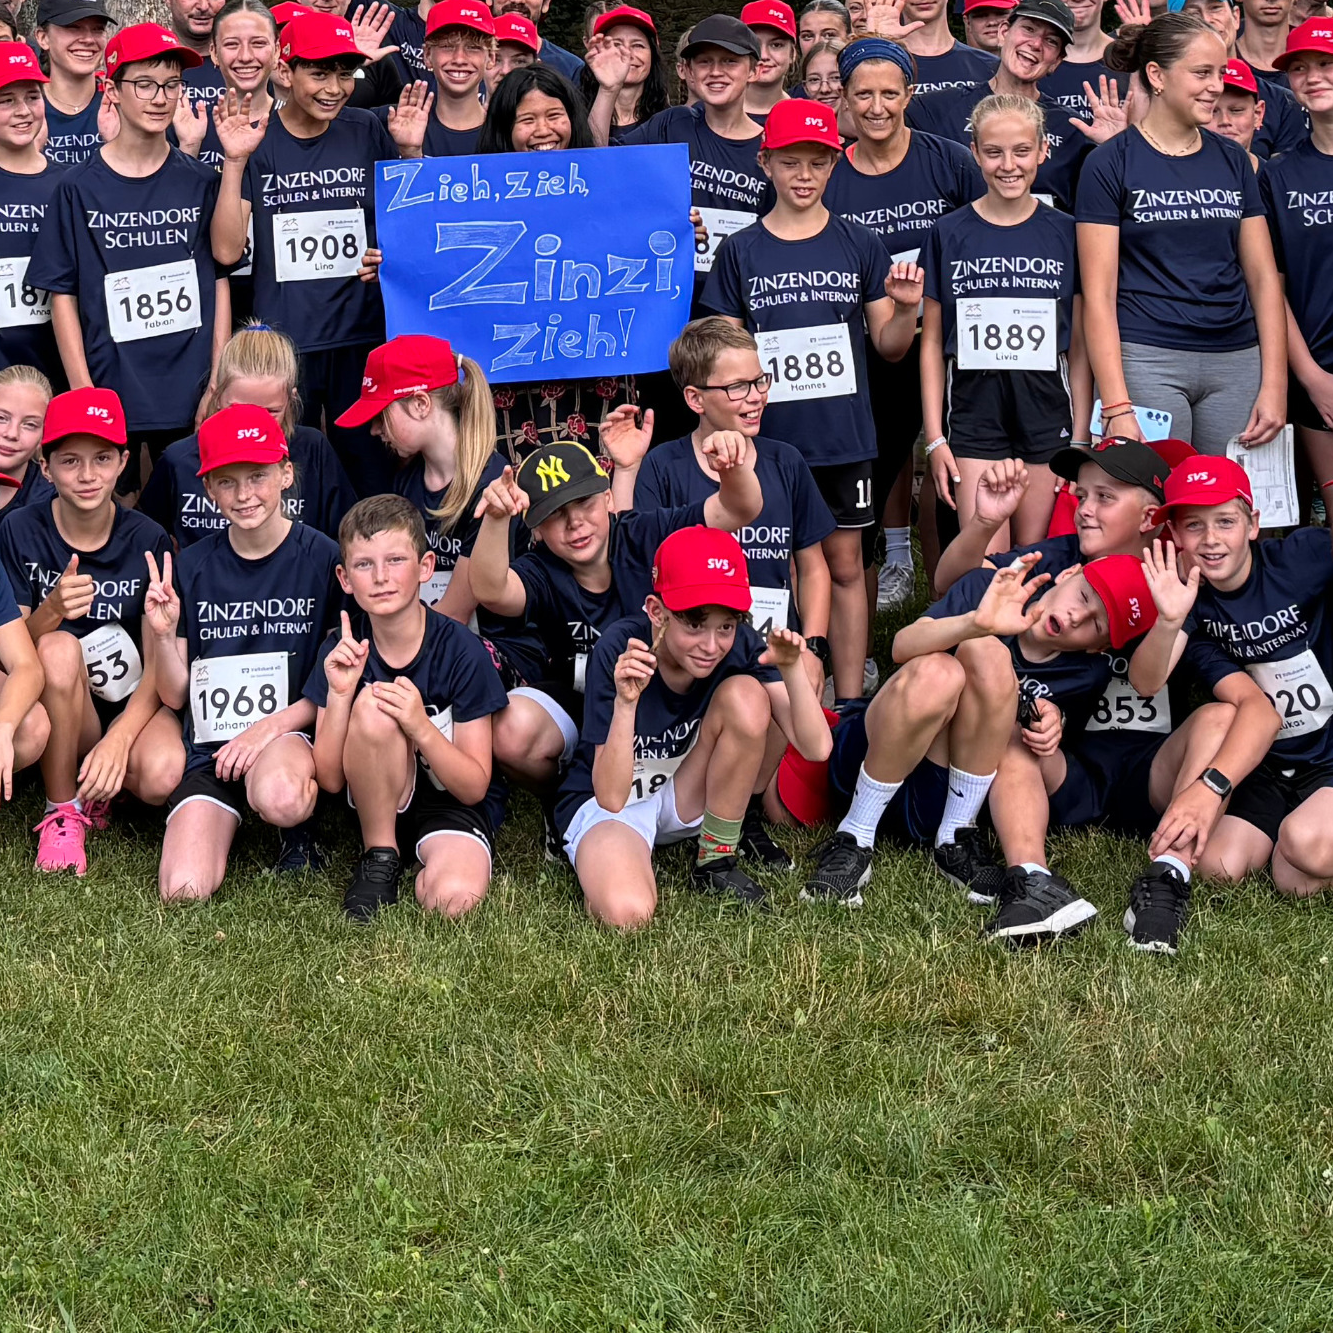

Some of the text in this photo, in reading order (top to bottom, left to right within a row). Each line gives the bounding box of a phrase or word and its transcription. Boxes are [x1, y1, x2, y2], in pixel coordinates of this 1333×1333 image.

[8, 56, 28, 64] SVS
[805, 117, 823, 127] SVS
[312, 191, 319, 200] &
[323, 187, 366, 198] INTERNAT
[384, 162, 501, 212] Zieh,
[1132, 189, 1242, 209] ZINZENDORF
[87, 207, 201, 229] ZINZENDORF
[1134, 208, 1199, 223] SCHULEN &
[31, 223, 40, 233] &
[104, 228, 188, 249] SCHULEN
[286, 233, 358, 263] 1908
[429, 221, 681, 312] Zinzi,
[951, 257, 1064, 280] ZINZENDORF
[749, 270, 860, 296] ZINZENDORF
[1001, 277, 1009, 287] &
[119, 286, 193, 323] 1856
[749, 290, 859, 310] SCHULEN & INTERNAT
[968, 323, 1046, 351] 1889
[768, 350, 844, 382] 1888
[996, 352, 1018, 361] Livia
[86, 407, 109, 418] SVS
[237, 428, 259, 439] SVS
[536, 455, 570, 491] NY
[1187, 472, 1208, 482] SVS
[707, 558, 728, 569] SVS
[743, 548, 789, 560] NTERNAT
[197, 598, 315, 622] ZINZENDORF
[200, 621, 313, 640] CHULEN & INTERNAT
[1247, 621, 1308, 657] & INTERNAT
[87, 649, 128, 687] 53
[199, 683, 278, 720] 1968
[1096, 695, 1157, 724] 853
[1267, 682, 1321, 717] 20
[1279, 718, 1305, 730] ukas
[632, 774, 666, 800] 18
